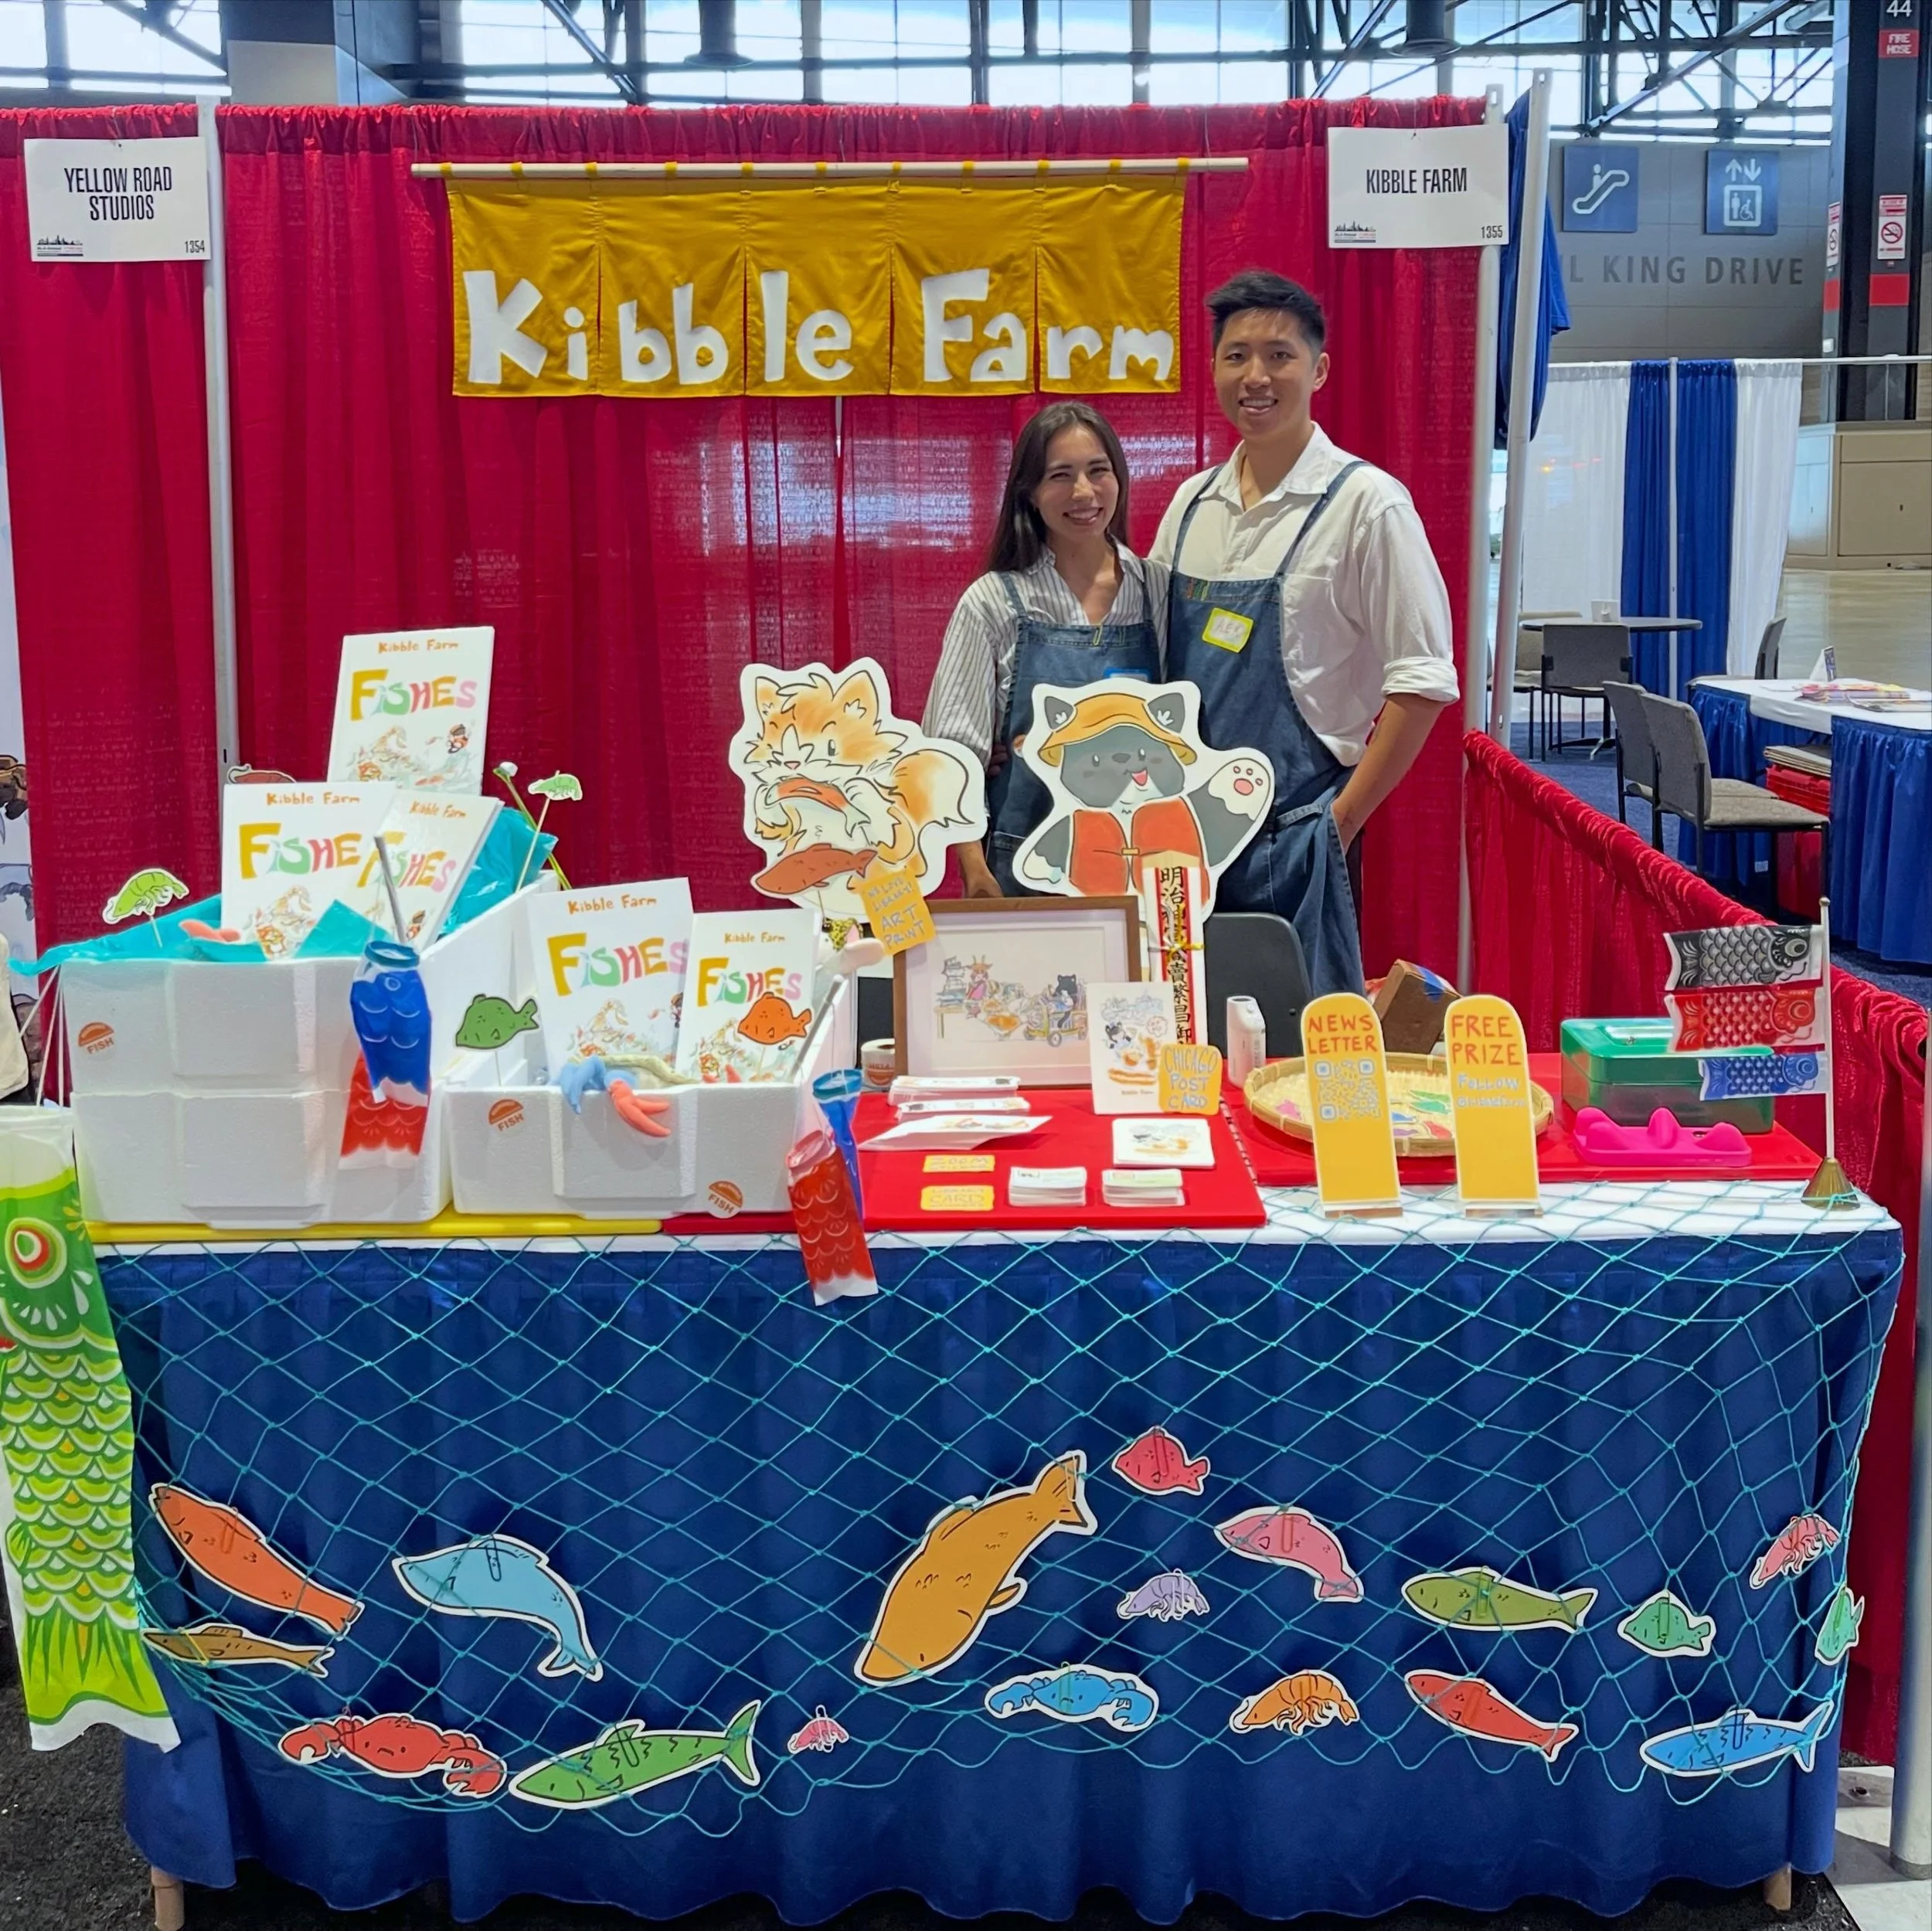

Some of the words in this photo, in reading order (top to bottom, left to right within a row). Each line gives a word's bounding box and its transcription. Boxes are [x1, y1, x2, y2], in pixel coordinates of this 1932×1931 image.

[1886, 0, 1913, 17] 44
[1889, 33, 1910, 43] FIRE
[1886, 44, 1913, 55] HOSE
[64, 168, 128, 192] YELLOW
[134, 166, 172, 192] ROAD
[1366, 168, 1417, 194] KIBBLE
[1423, 168, 1468, 193] FARM
[90, 195, 155, 220] STUDIOS
[1481, 225, 1503, 239] 1355
[185, 240, 206, 253] 1354
[1603, 256, 1685, 284] KING
[1706, 257, 1804, 285] DRIVE
[464, 270, 854, 384] Kibble
[921, 268, 1175, 382] Farm
[378, 641, 420, 654] Kibble
[427, 638, 459, 651] Farm
[267, 792, 314, 805] Kibble
[323, 792, 360, 804] Farm
[410, 800, 440, 815] Kibble
[443, 804, 467, 818] Farm
[568, 896, 614, 914] Kibble
[621, 894, 657, 909] Farm
[881, 903, 918, 933] ART
[724, 933, 755, 944] Kibble
[761, 932, 786, 943] Farm
[883, 920, 926, 950] PRINT
[1308, 1014, 1373, 1034] NEWS
[1451, 1015, 1514, 1038] FREE
[87, 1036, 114, 1054] FISH
[1308, 1035, 1379, 1055] LETTER
[1452, 1043, 1522, 1066] PRIZE
[1165, 1046, 1219, 1074] CHICAGO
[1170, 1073, 1209, 1091] POST
[1168, 1093, 1209, 1110] CARD
[498, 1113, 524, 1131] FISH
[708, 1194, 734, 1214] FISH
